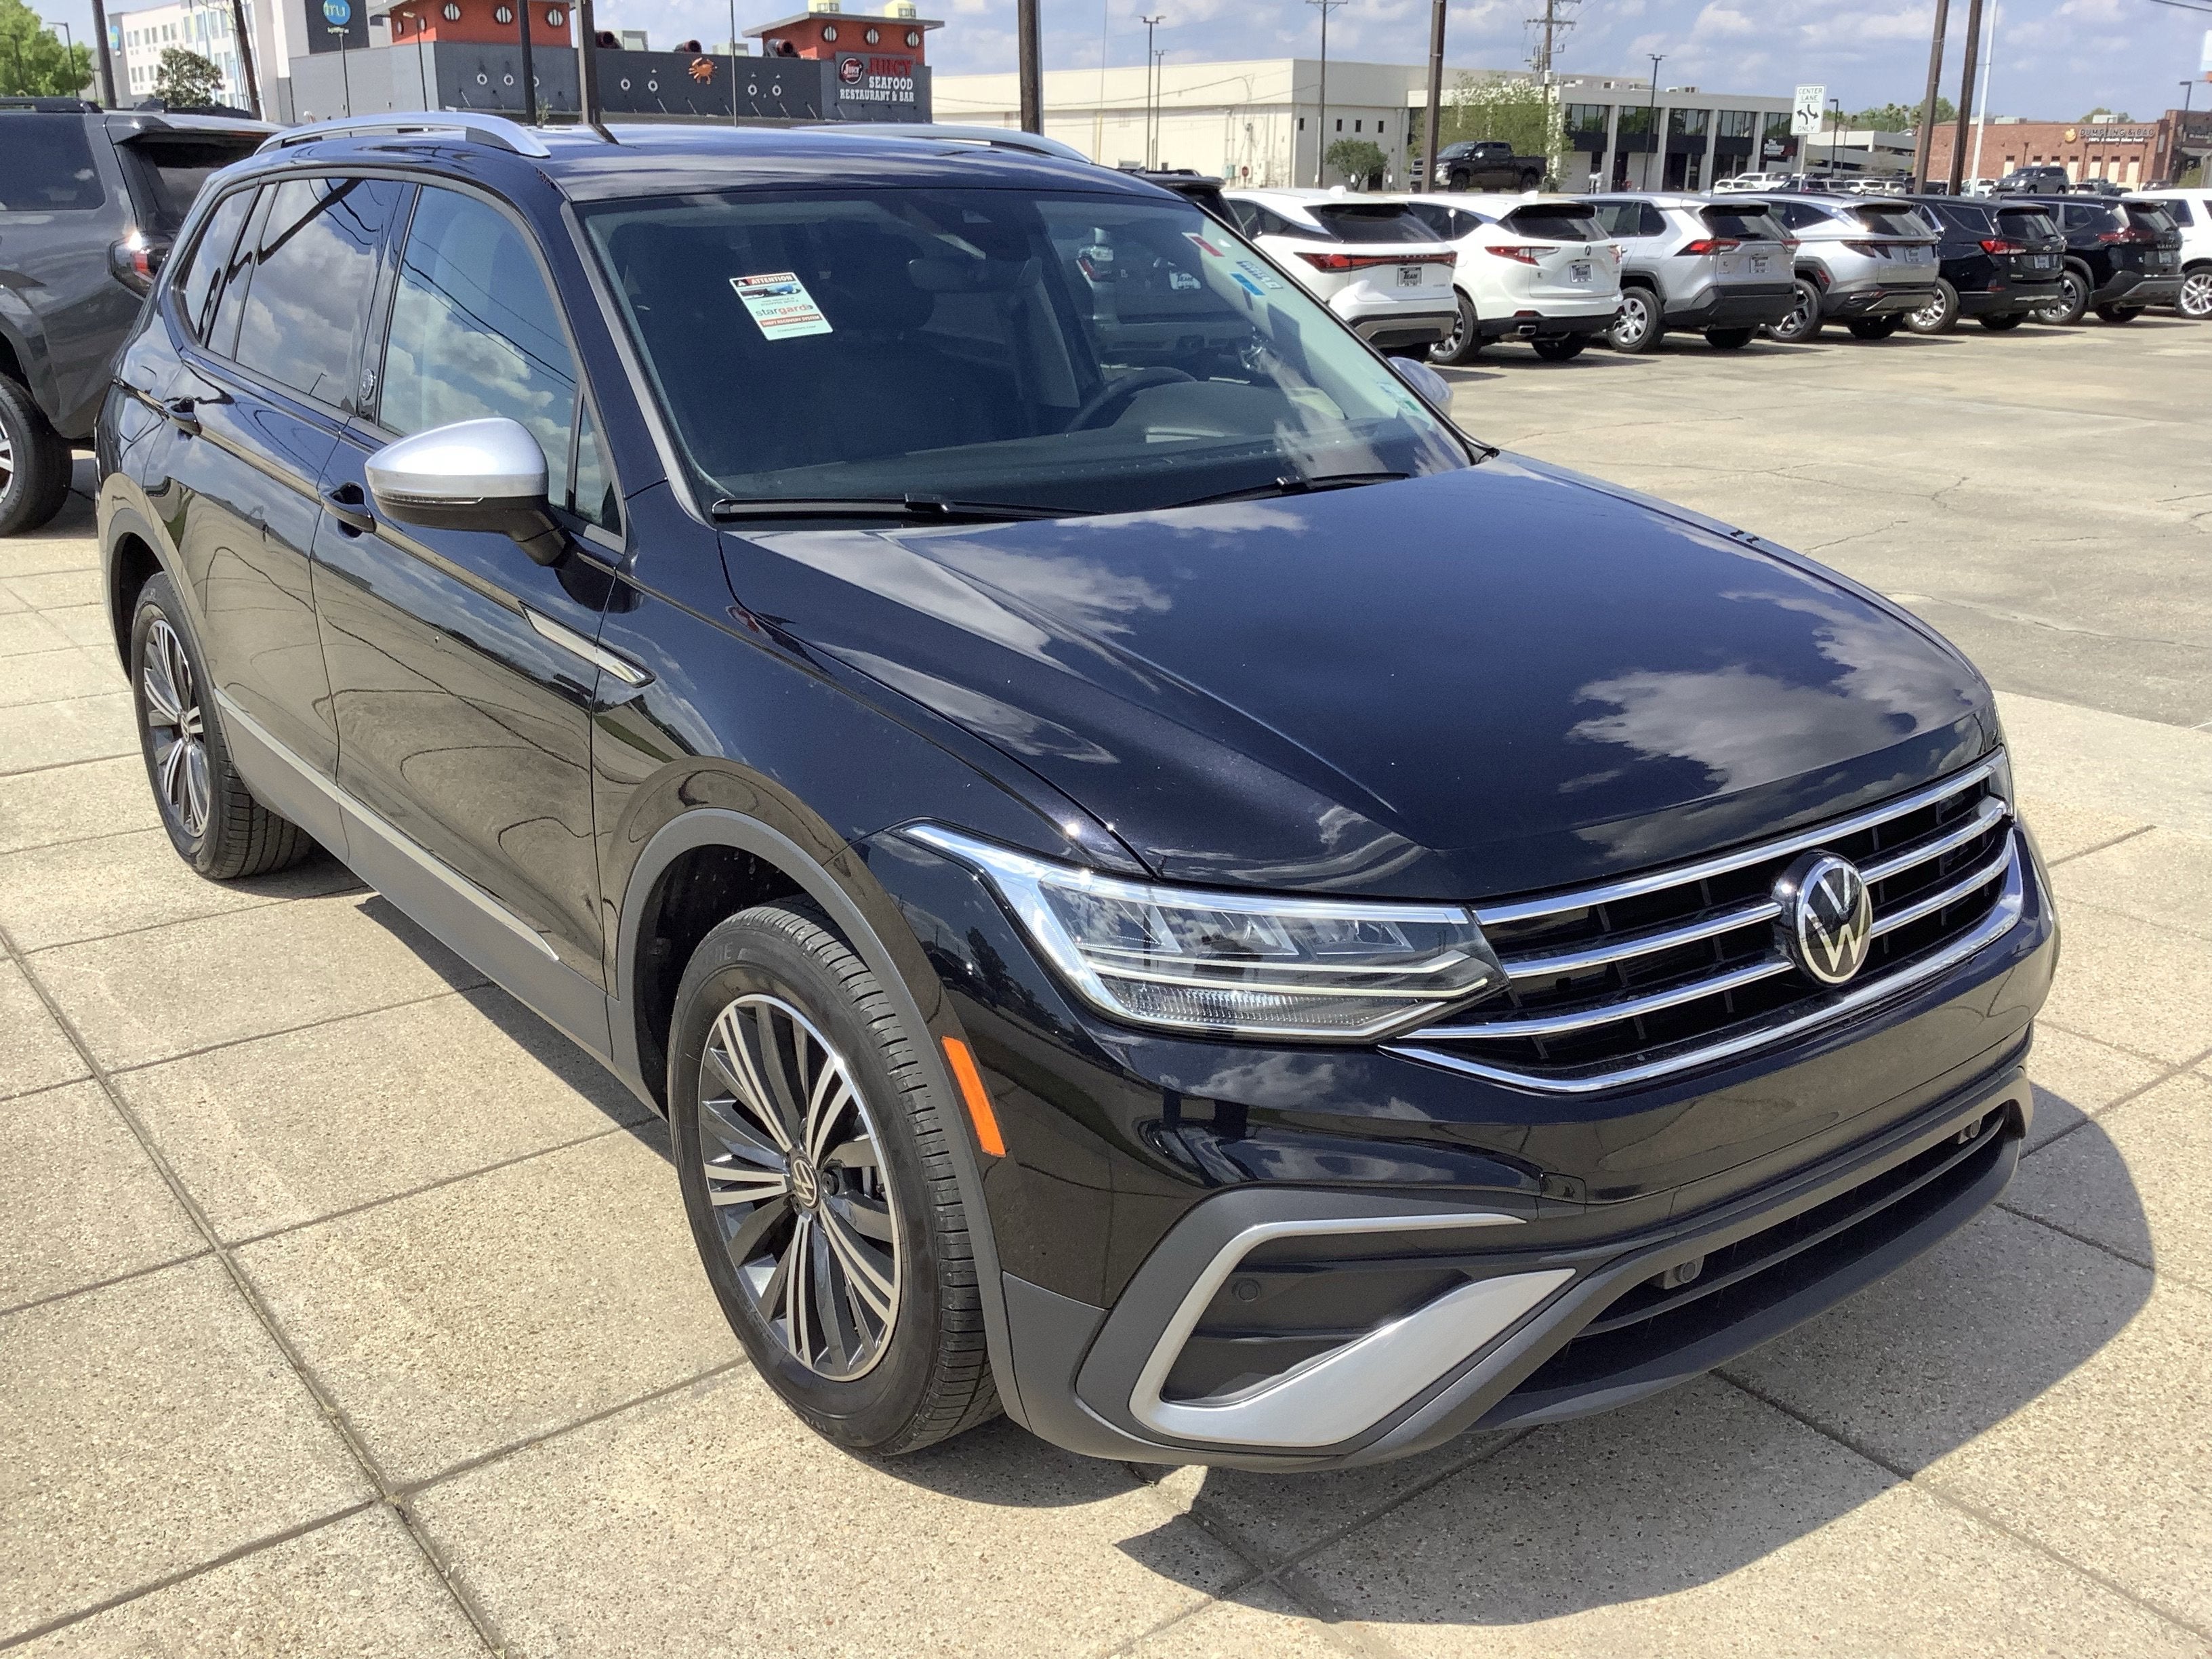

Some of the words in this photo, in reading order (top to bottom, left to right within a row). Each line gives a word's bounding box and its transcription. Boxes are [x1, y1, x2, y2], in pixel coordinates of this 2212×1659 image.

[867, 58, 912, 76] JUICY
[869, 76, 914, 90] SEAFOOD
[840, 89, 890, 101] RESTAURANT
[892, 91, 897, 101] &
[899, 91, 914, 102] BAR
[751, 274, 793, 285] ATTENTION
[1404, 271, 1418, 279] TEAM
